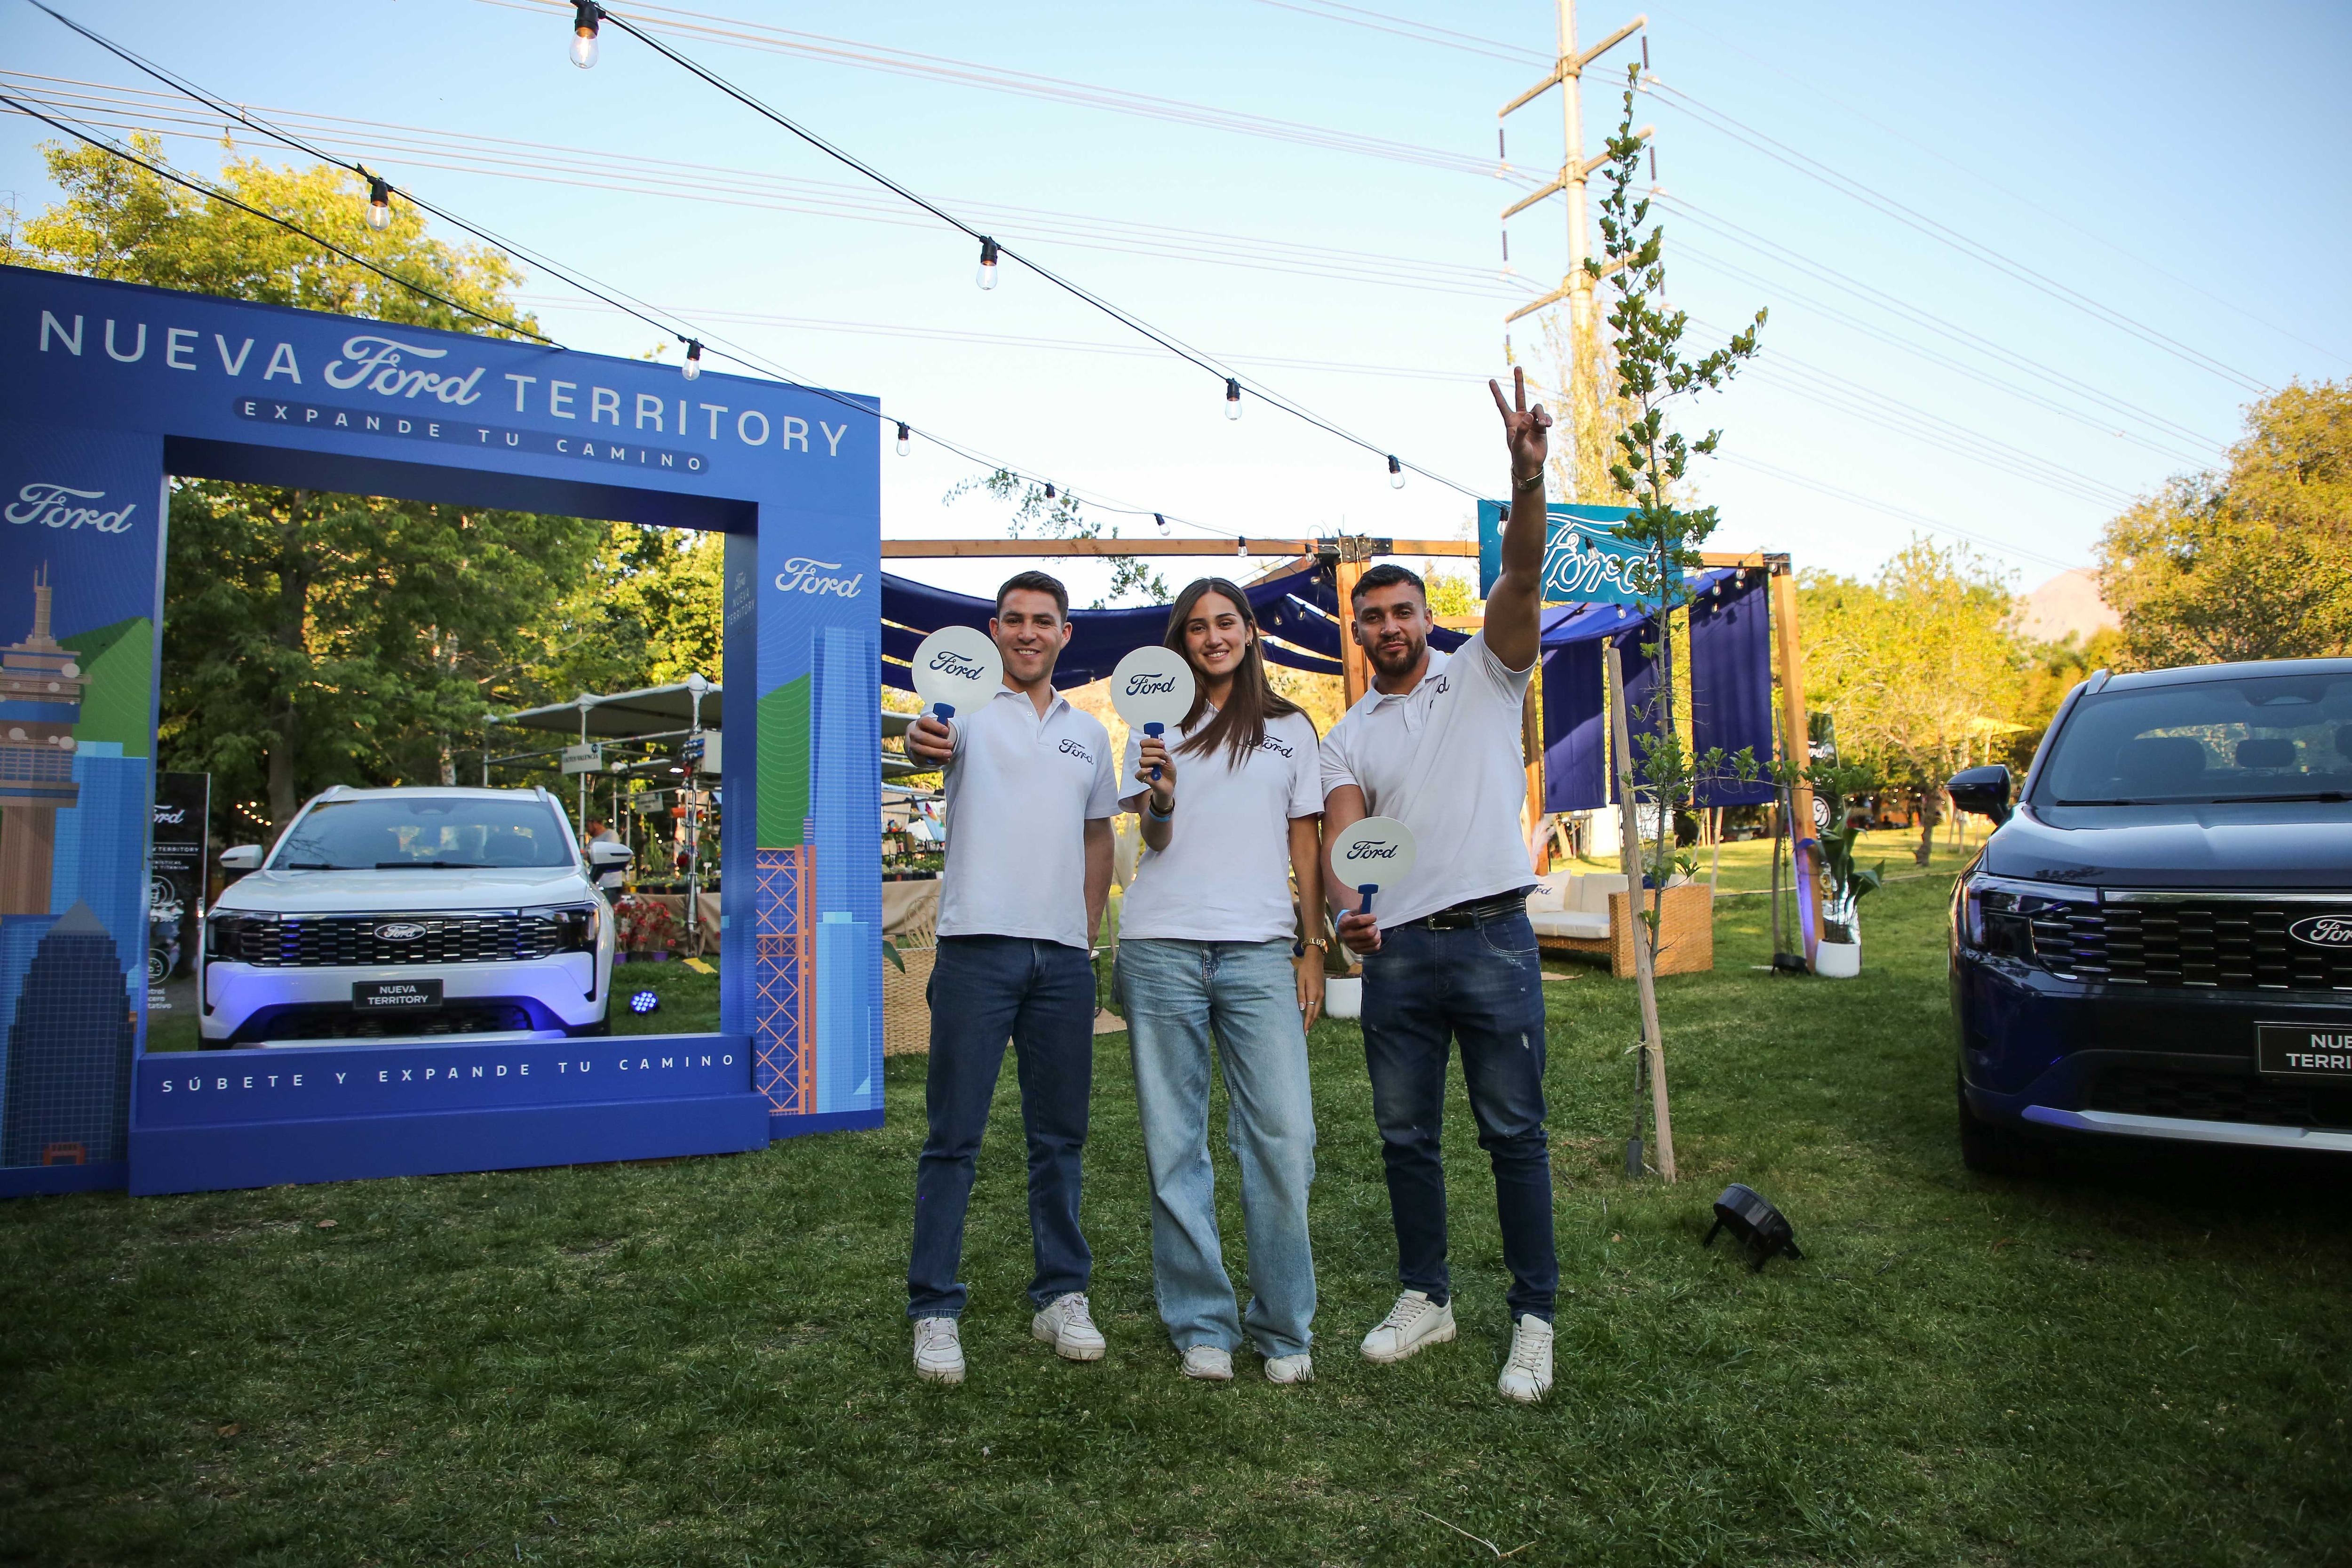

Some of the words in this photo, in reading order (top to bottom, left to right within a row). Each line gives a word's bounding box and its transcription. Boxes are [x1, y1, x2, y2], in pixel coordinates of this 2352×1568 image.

[40, 310, 302, 384] NUEVA
[324, 335, 486, 406] Ford
[505, 373, 848, 457] TERRITORY
[245, 402, 440, 438] EXPANDE
[478, 429, 518, 446] TU
[556, 439, 700, 470] CAMINO
[5, 483, 137, 533] Ford
[775, 557, 863, 598] Ford
[733, 588, 749, 608] NUEVA
[727, 598, 755, 626] TERRITORY
[930, 651, 985, 680] Ford
[1126, 673, 1176, 696] Ford
[1058, 739, 1094, 765] Ford
[1346, 841, 1398, 860] Ford
[384, 925, 416, 938] Ford
[2310, 919, 2352, 941] For
[367, 995, 429, 1005] TERRITORY
[380, 986, 417, 994] NUEVA
[2311, 1034, 2352, 1049] NUE
[2286, 1053, 2351, 1069] TERRI
[162, 1075, 303, 1092] SÚBETE
[335, 1073, 346, 1084] Y
[379, 1064, 529, 1082] EXPANDE
[558, 1061, 590, 1073] TU
[619, 1055, 732, 1070] CAMINO
